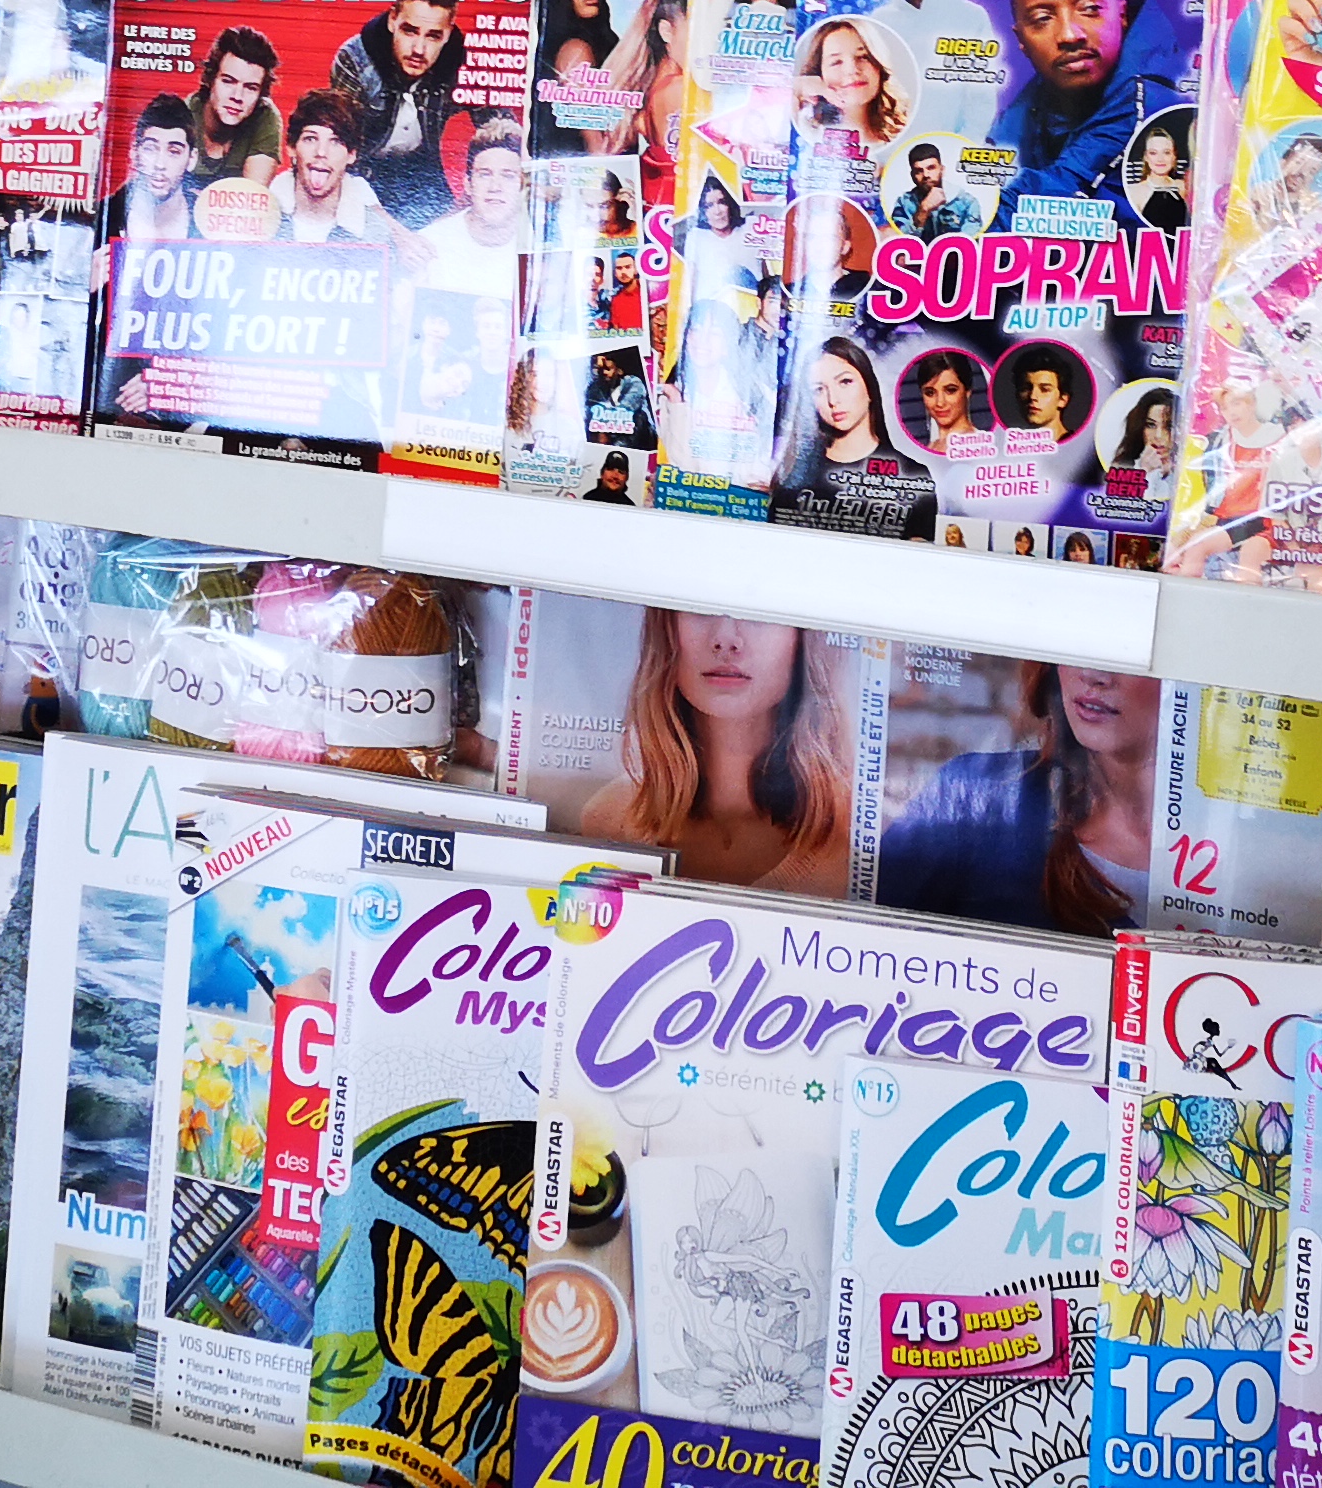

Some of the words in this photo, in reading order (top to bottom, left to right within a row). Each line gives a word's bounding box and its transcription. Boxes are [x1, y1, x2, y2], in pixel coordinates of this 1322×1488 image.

[936, 38, 998, 58] BIGFLO
[0, 141, 31, 165] DES
[36, 143, 73, 167] DVD
[208, 189, 269, 212] DOSSIER
[1020, 197, 1112, 220] INTERVIEW
[120, 249, 245, 311] FOUR,
[261, 267, 379, 304] ENCORE
[118, 308, 211, 352] PLUS
[225, 313, 329, 354] FORT
[1006, 309, 1040, 333] AU
[1047, 306, 1091, 330] TOP
[949, 432, 994, 447] Camila
[949, 444, 997, 460] Cabello
[658, 466, 683, 486] Et
[687, 469, 730, 491] aussi
[975, 462, 1036, 481] QUELLE
[541, 713, 626, 733] FANTAISIE,
[541, 734, 612, 752] COULEURS
[205, 817, 292, 878] NOUVEAU
[365, 828, 451, 866] SECRETS
[563, 901, 613, 928] N°10
[1163, 893, 1225, 918] patrons
[1229, 906, 1279, 927] mode
[781, 926, 999, 995] Moments
[1013, 963, 1059, 1004] de
[575, 918, 1092, 1088] Coloriage
[703, 1069, 797, 1097] sérénité
[891, 1300, 959, 1343] 48
[965, 1299, 1041, 1334] pages
[891, 1334, 1040, 1367] détachables
